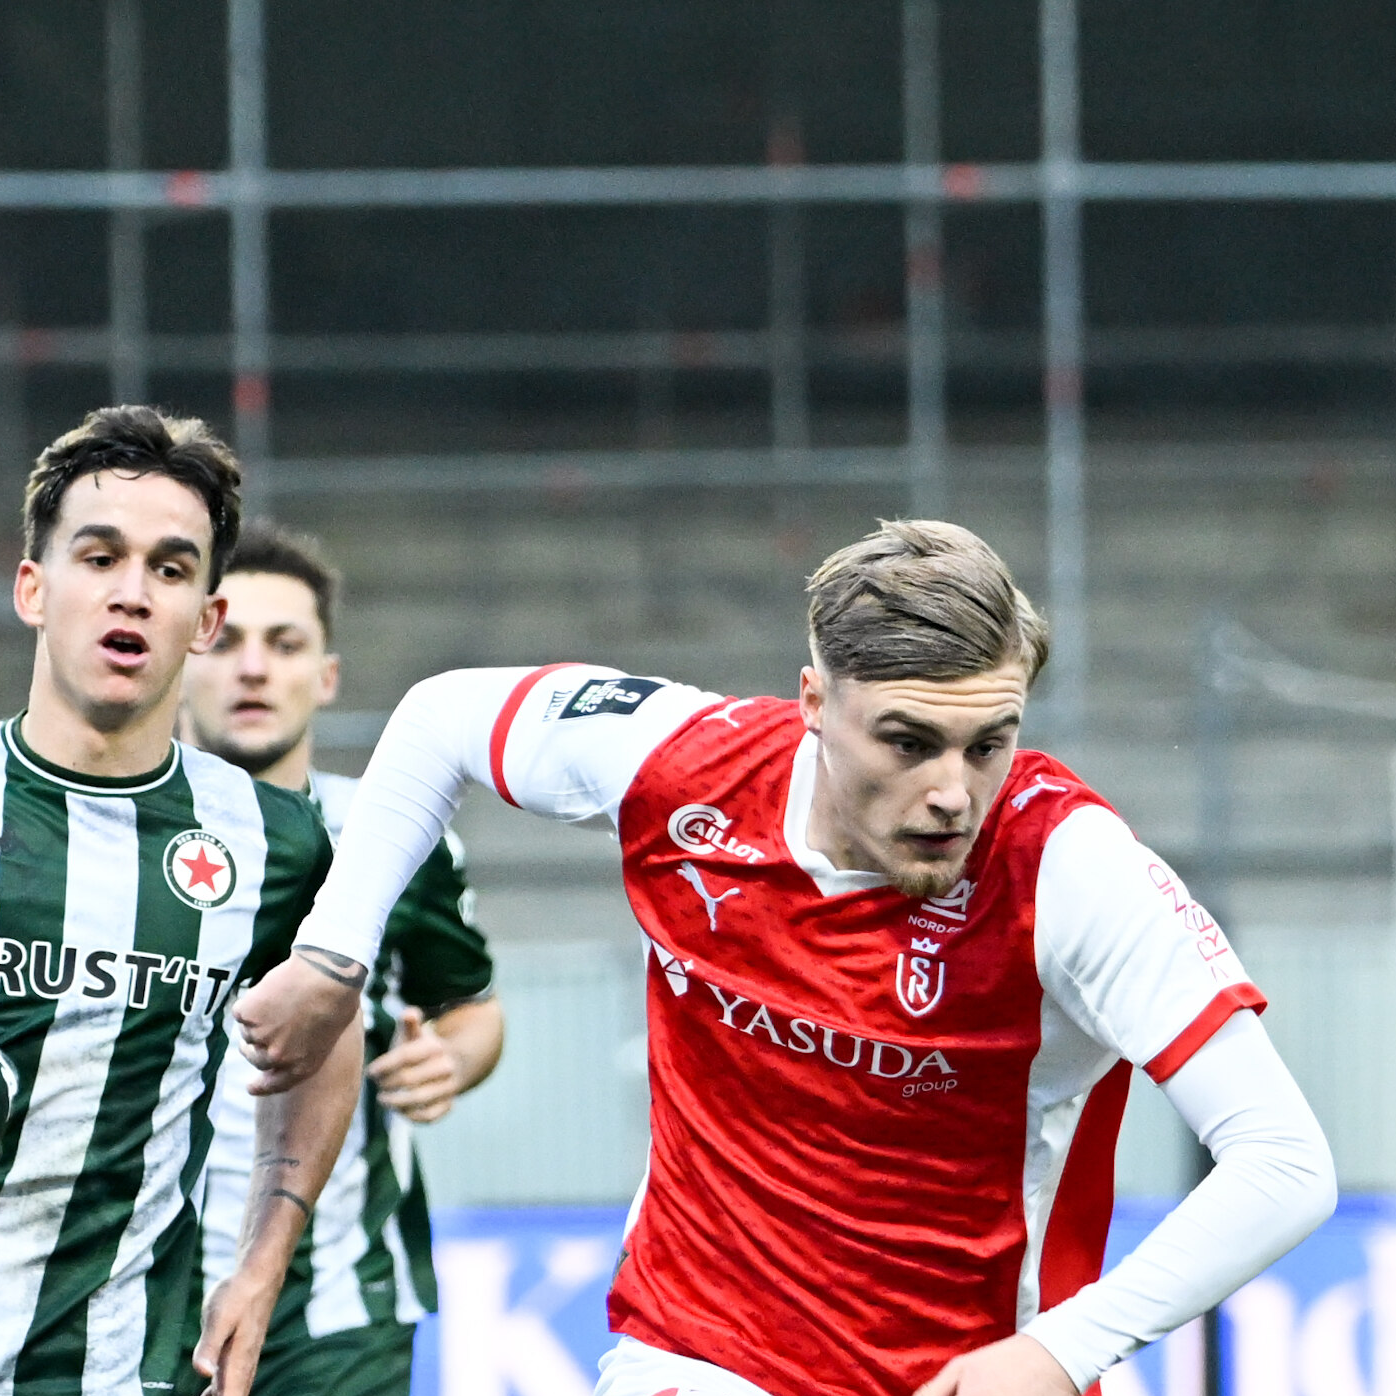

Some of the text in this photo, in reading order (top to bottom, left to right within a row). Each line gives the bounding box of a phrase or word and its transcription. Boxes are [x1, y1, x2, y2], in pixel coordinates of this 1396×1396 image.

[667, 803, 766, 864] CAILLOT
[907, 914, 946, 935] NORD
[705, 981, 958, 1079] YASUDA
[902, 1078, 958, 1097] group
